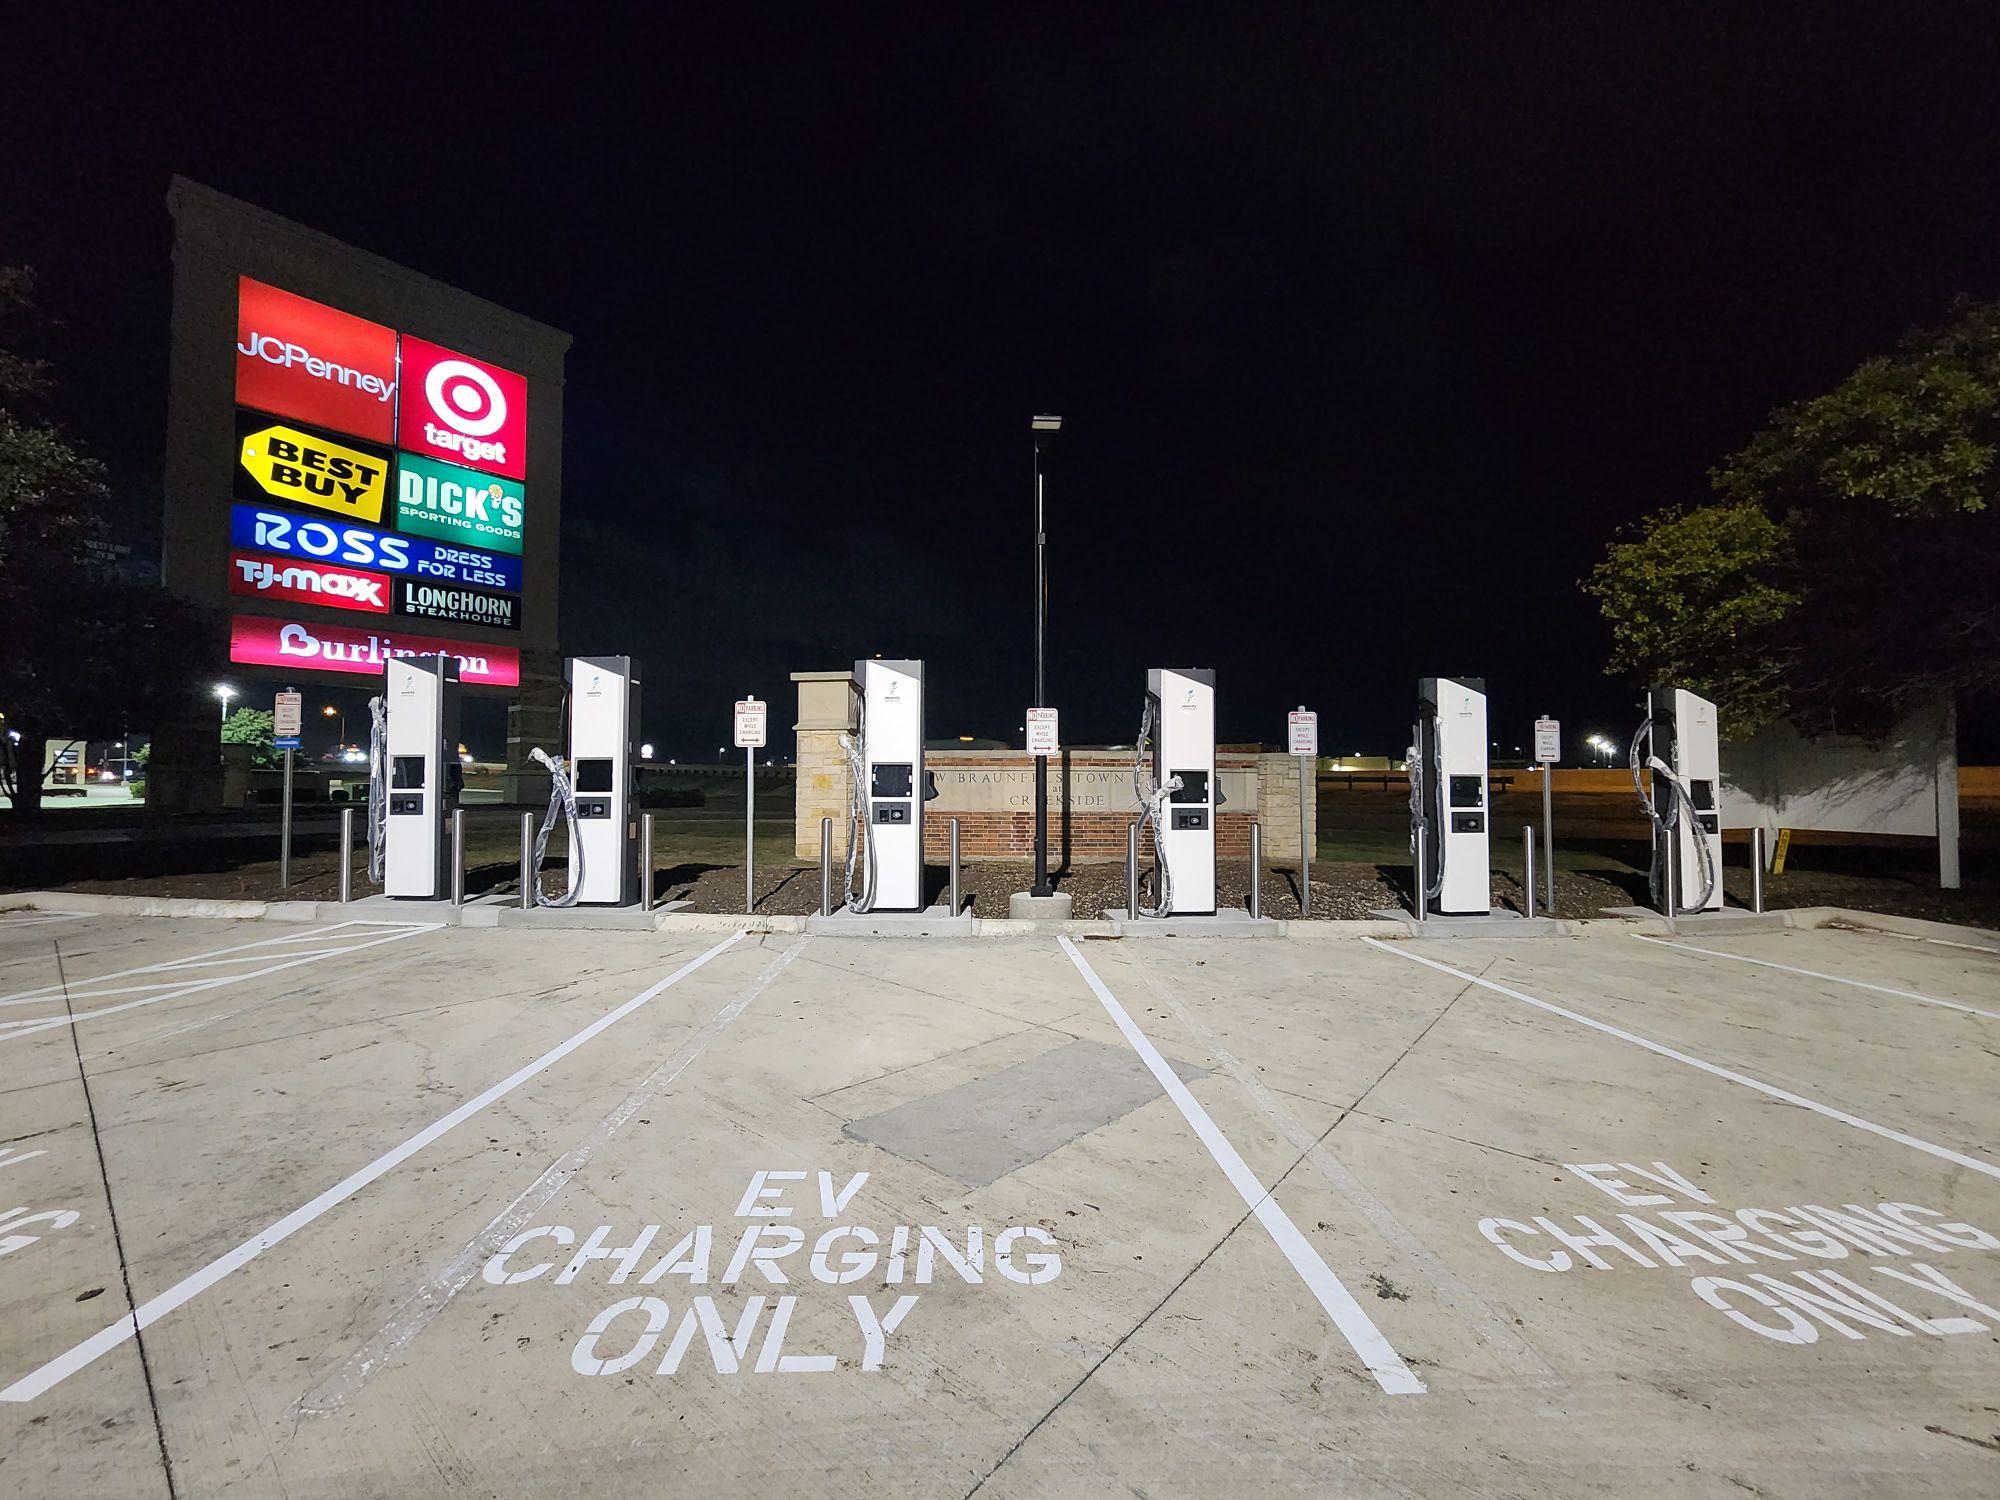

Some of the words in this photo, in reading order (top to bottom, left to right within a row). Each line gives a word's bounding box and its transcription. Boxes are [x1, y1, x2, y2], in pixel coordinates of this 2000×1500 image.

[237, 332, 395, 402] JCPenney
[267, 437, 379, 486] BEST
[424, 423, 505, 463] target
[271, 462, 369, 504] BUY
[399, 469, 522, 527] DICK'S
[255, 512, 409, 569] ROSS
[400, 506, 472, 529] SPORTING
[475, 523, 521, 539] GOODS
[418, 560, 455, 578] FOR
[462, 568, 506, 587] LESS
[434, 547, 492, 569] DRESS
[406, 583, 511, 617] LONGHORN
[406, 604, 511, 626] STEAKHOUSE
[1073, 773, 1125, 783] TOWN
[734, 1171, 870, 1217] EV
[1564, 1162, 1716, 1206] EV
[482, 1225, 1062, 1284] CHARGING
[1478, 1202, 2000, 1272] CHARGING
[1691, 1263, 2000, 1344] ONLY
[571, 1295, 919, 1376] ONLY
